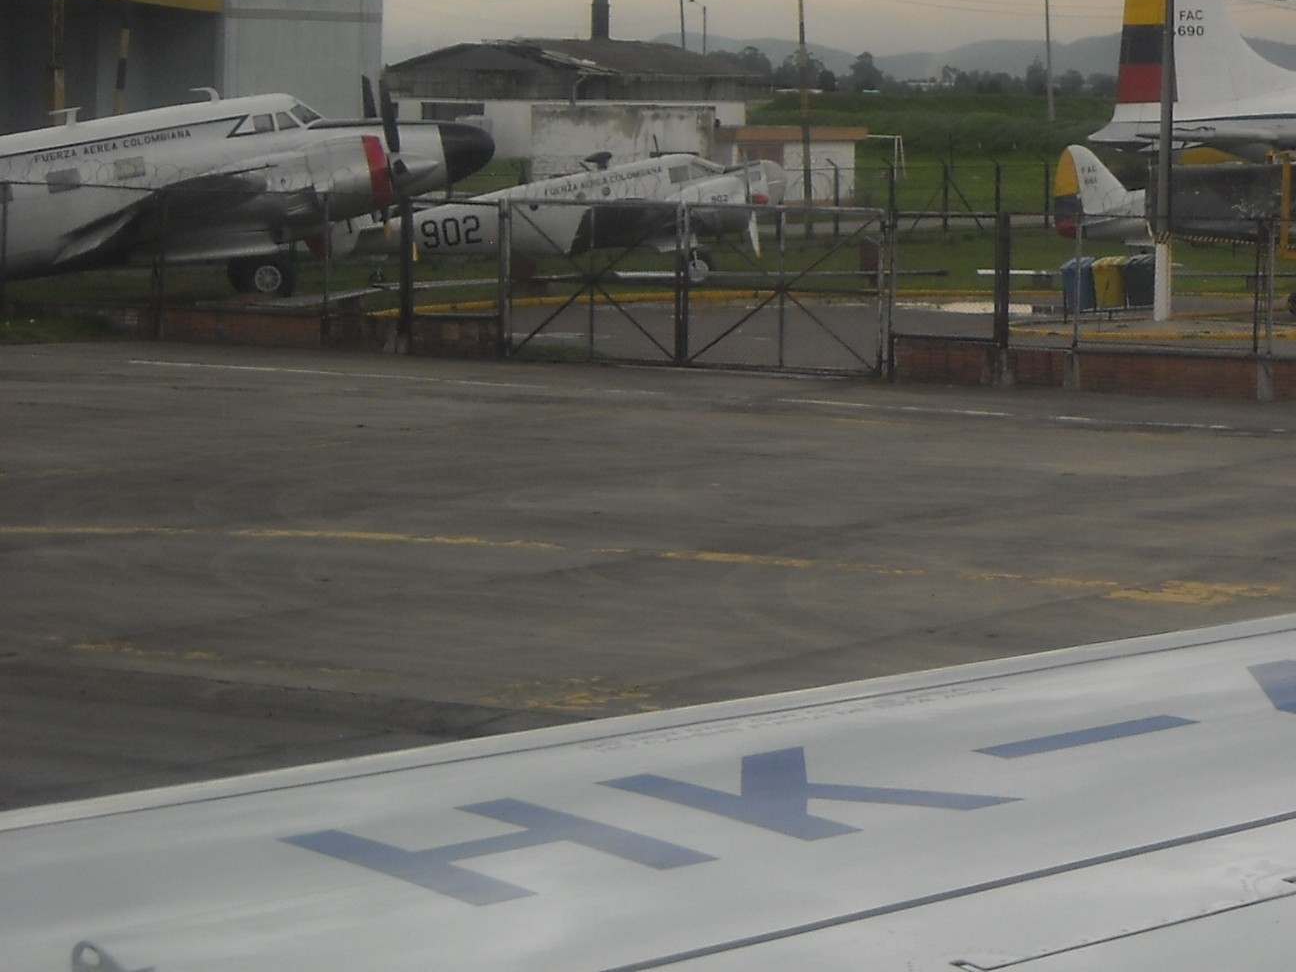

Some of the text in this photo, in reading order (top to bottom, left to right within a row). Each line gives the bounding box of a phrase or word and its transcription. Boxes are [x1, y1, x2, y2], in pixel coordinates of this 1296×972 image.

[1179, 10, 1204, 21] FAC
[1177, 25, 1205, 37] 690
[34, 129, 192, 164] FUERZA AEREA COLOMBIANA
[421, 215, 482, 250] 902
